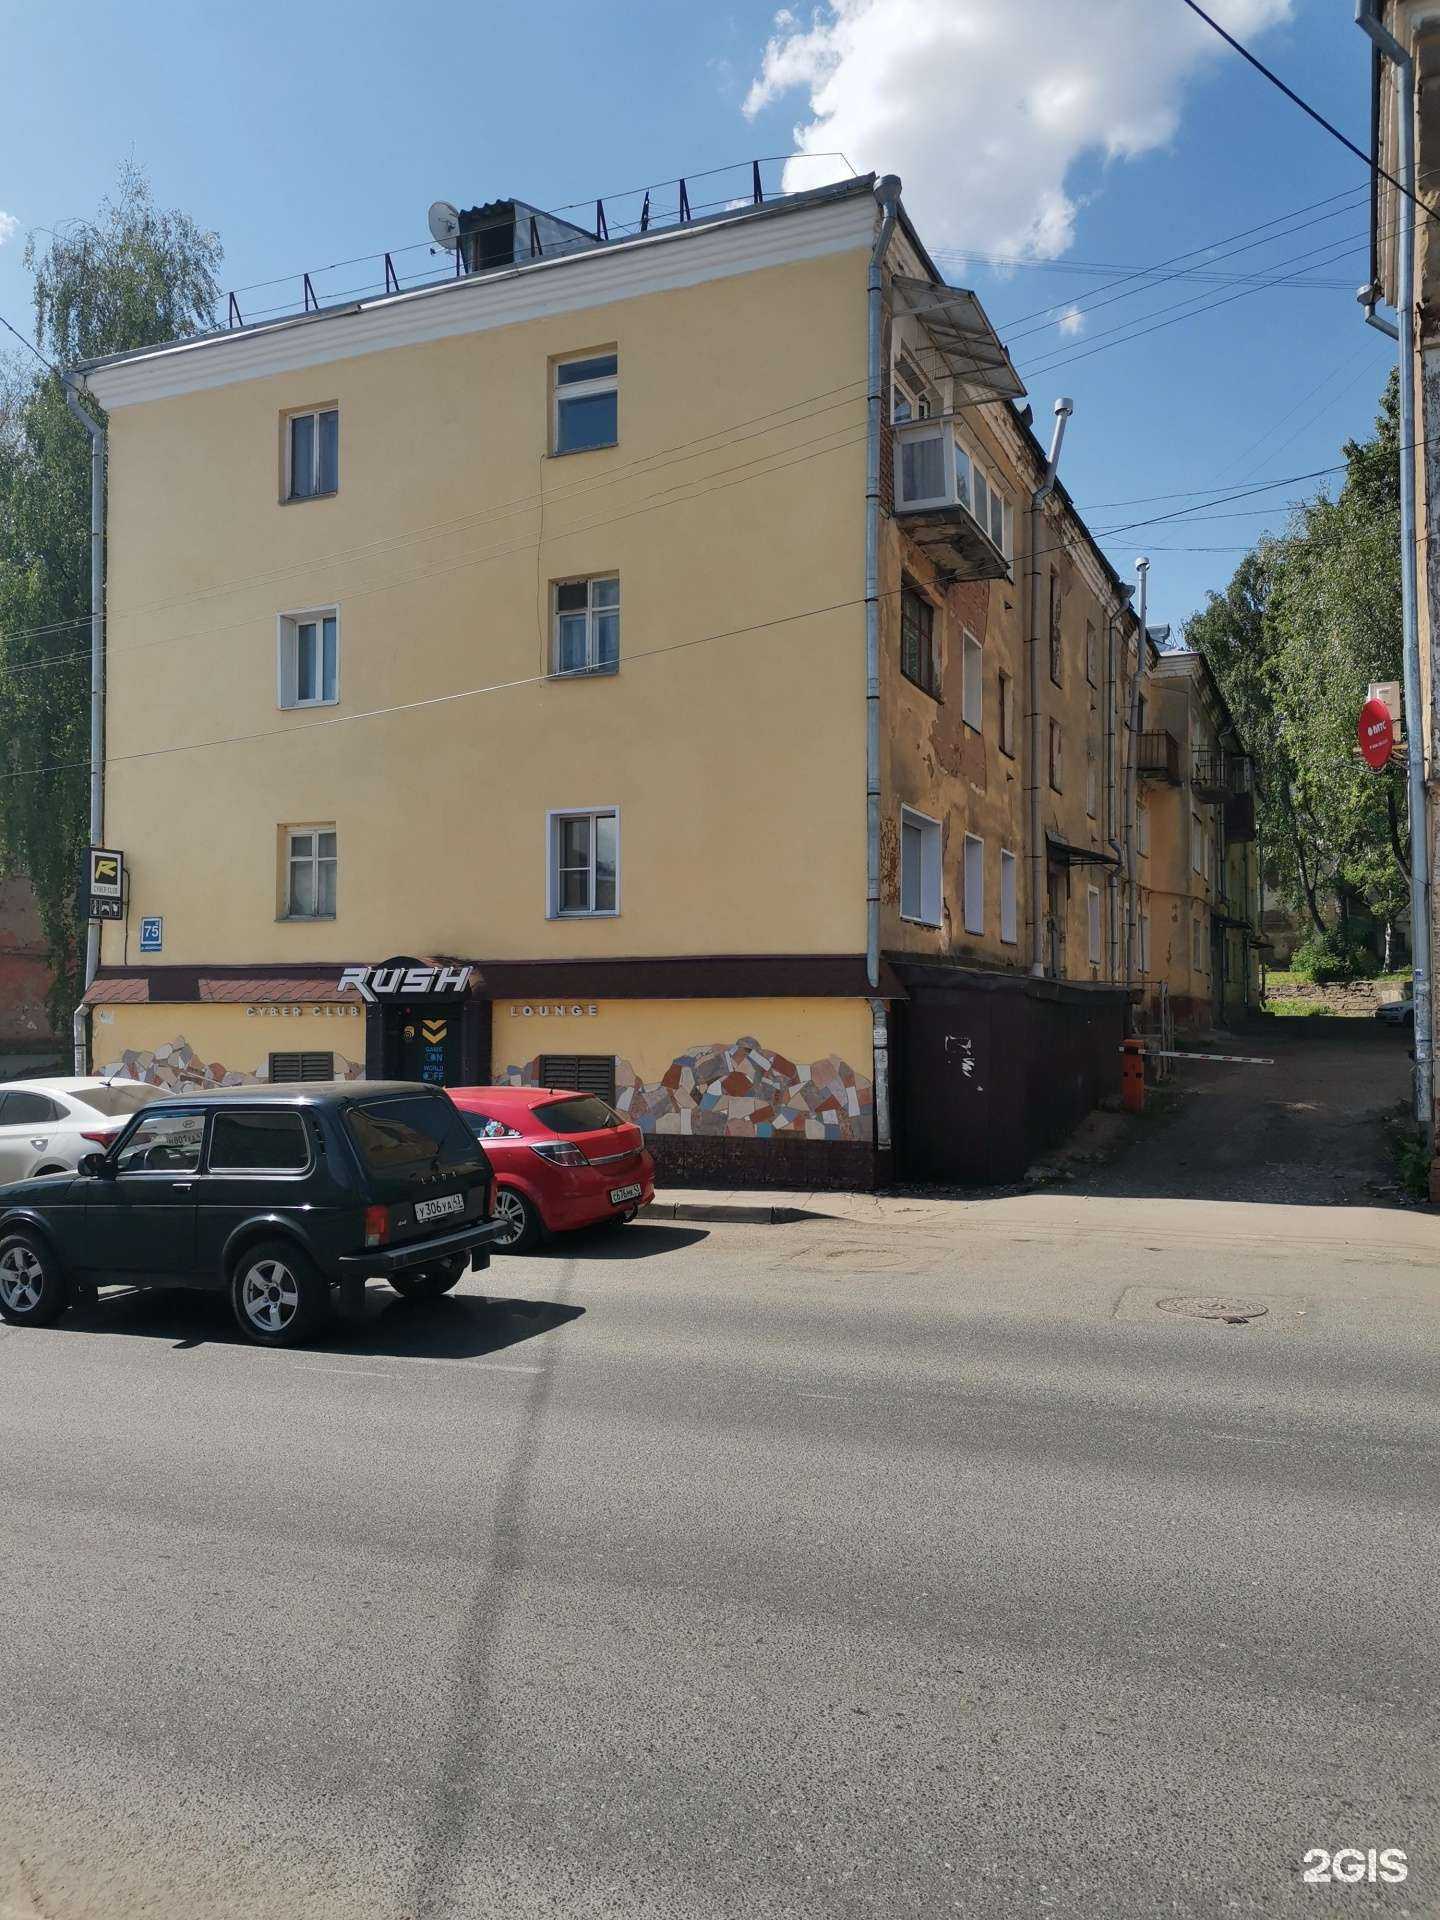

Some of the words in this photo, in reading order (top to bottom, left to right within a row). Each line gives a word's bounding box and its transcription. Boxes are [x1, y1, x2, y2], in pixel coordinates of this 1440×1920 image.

[144, 925, 159, 937] 75
[337, 965, 473, 1002] RUSH
[246, 1006, 301, 1017] CYBER
[312, 1006, 360, 1017] CLUB
[510, 1004, 598, 1016] LOUNGE
